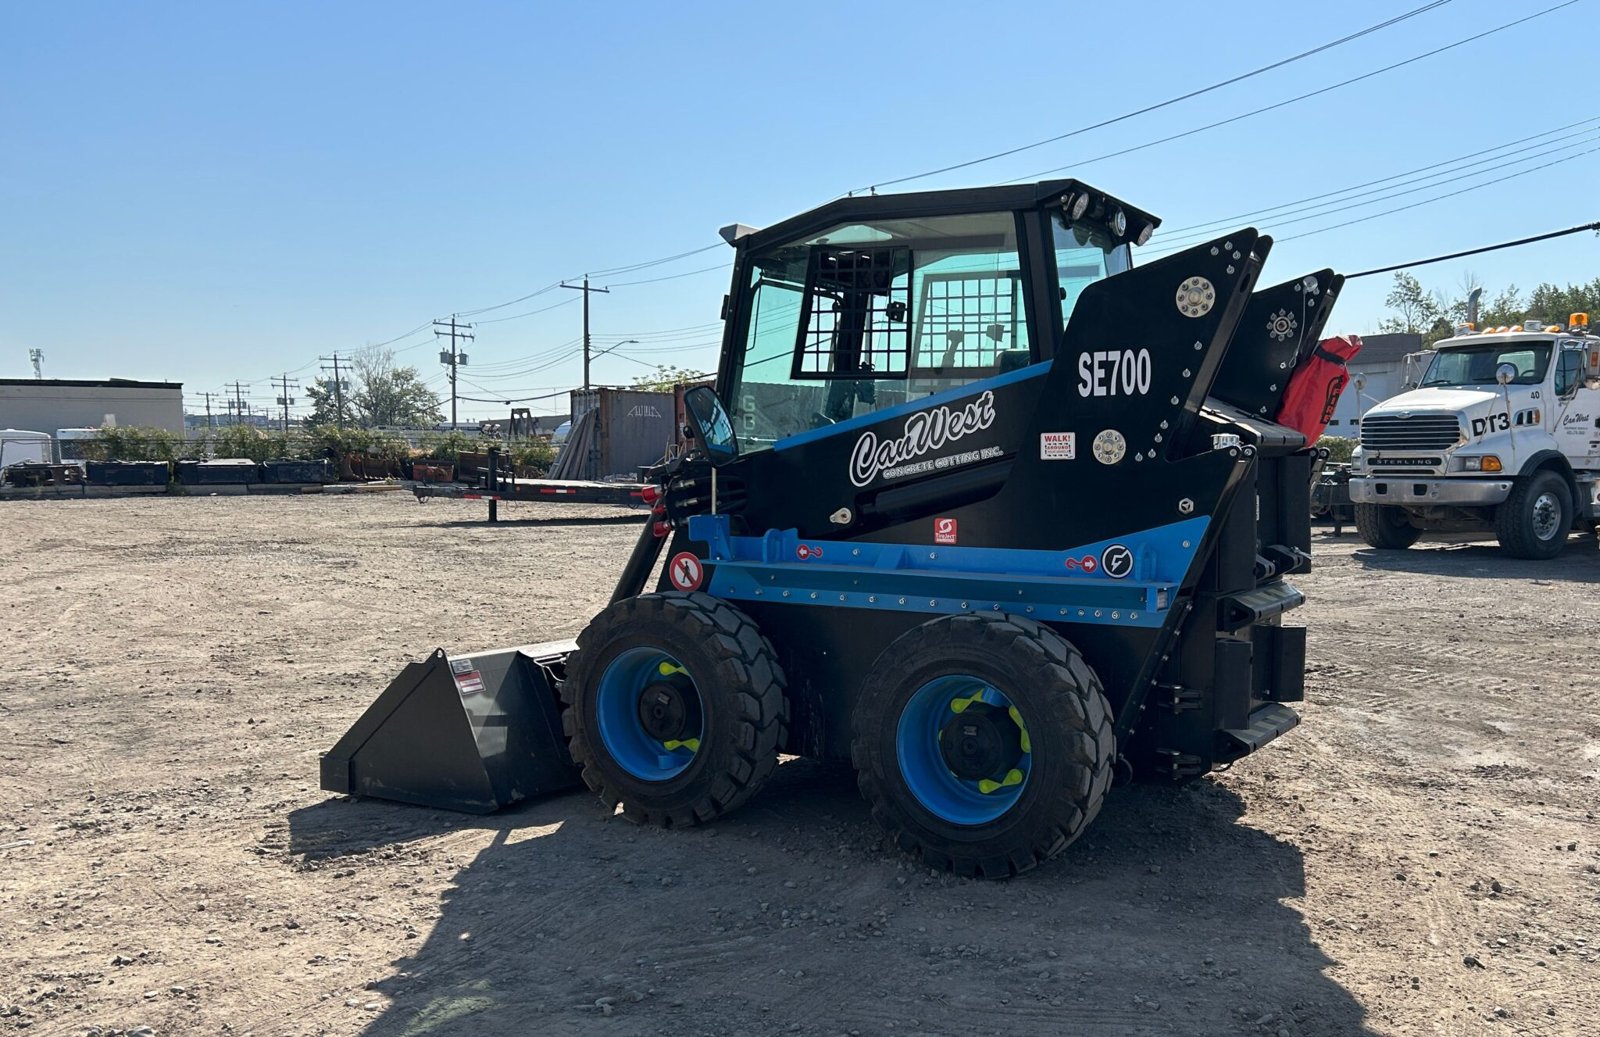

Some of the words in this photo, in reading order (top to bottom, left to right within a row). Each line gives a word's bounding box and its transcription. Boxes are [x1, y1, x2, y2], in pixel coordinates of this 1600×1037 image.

[1077, 347, 1152, 398] SE700
[1530, 391, 1540, 400] 40
[849, 390, 996, 487] CanWest
[1044, 434, 1071, 442] WALK!
[1471, 412, 1510, 437] DT3
[882, 460, 934, 480] CONCRETE
[934, 451, 981, 469] CUTTING
[980, 446, 1004, 459] INC.
